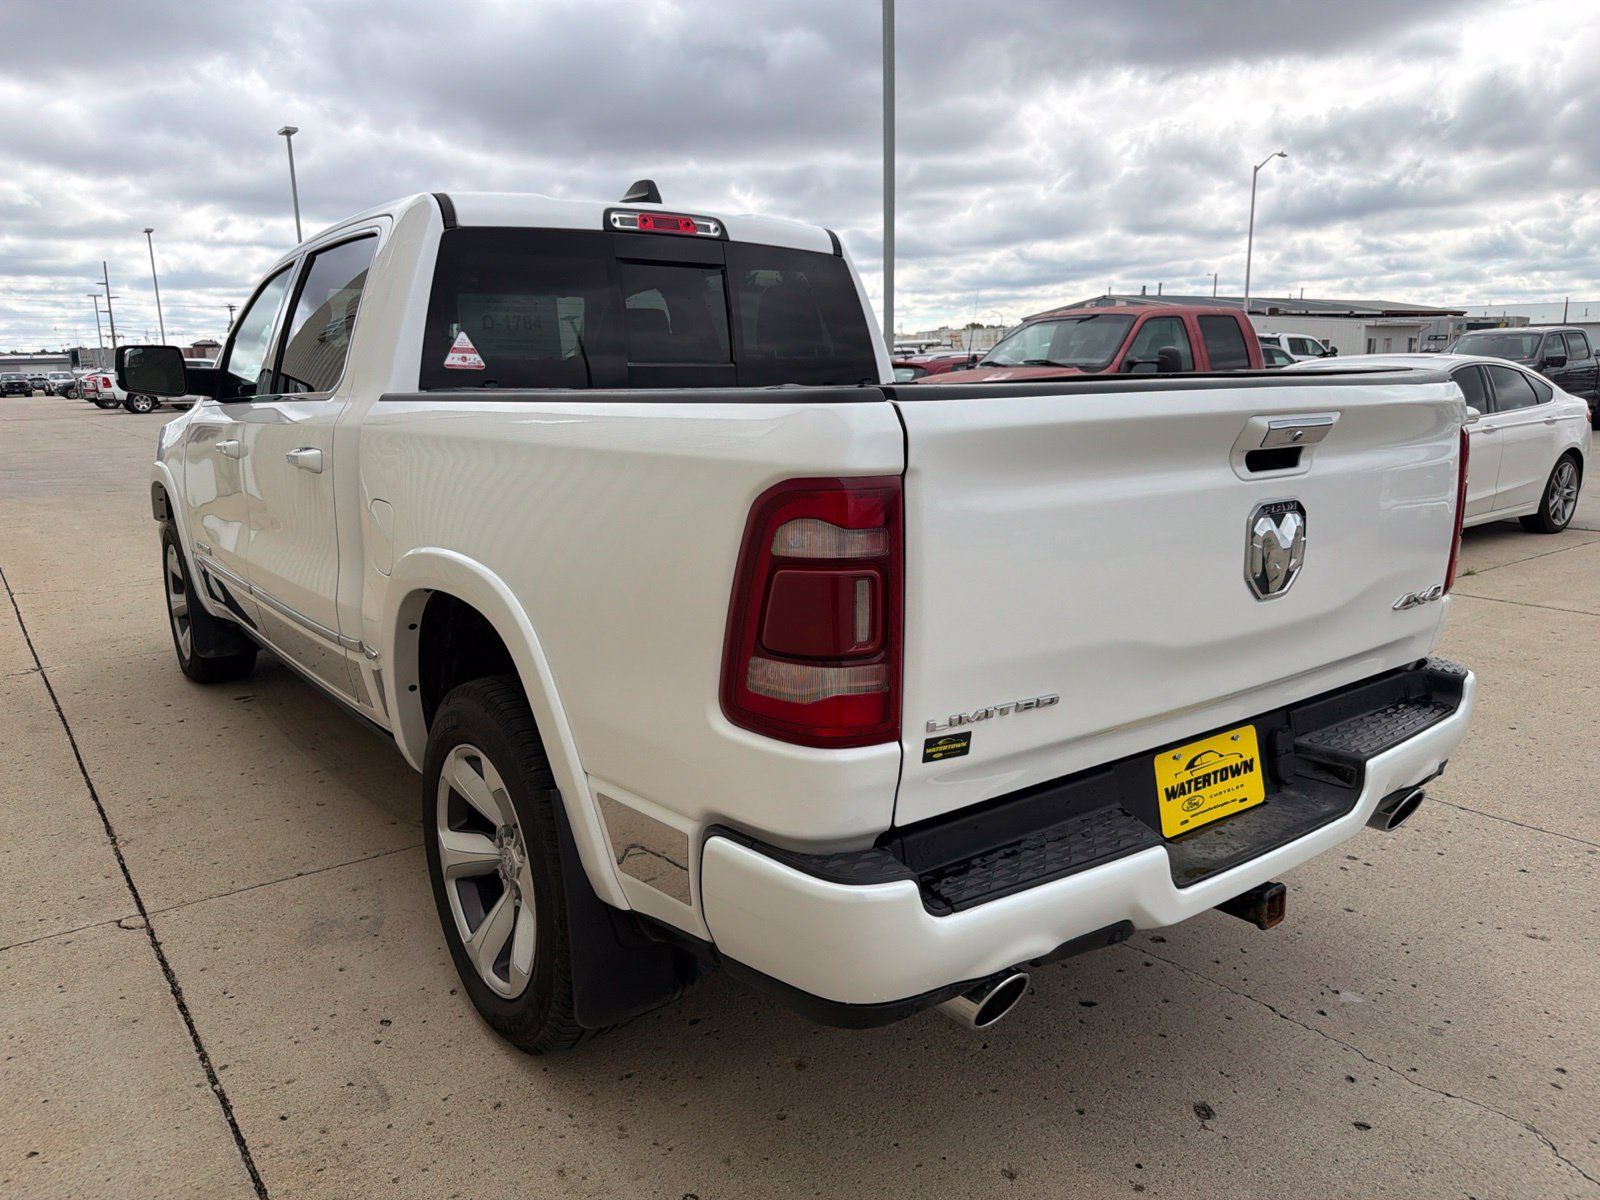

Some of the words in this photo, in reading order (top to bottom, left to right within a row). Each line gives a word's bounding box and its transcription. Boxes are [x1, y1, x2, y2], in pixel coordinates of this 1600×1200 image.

[1265, 502, 1298, 514] RAM
[926, 693, 1060, 733] LIMITED
[926, 741, 968, 754] WATERTOWN
[1164, 757, 1255, 802] WATERTOWN
[1209, 784, 1244, 799] CHRYSLER
